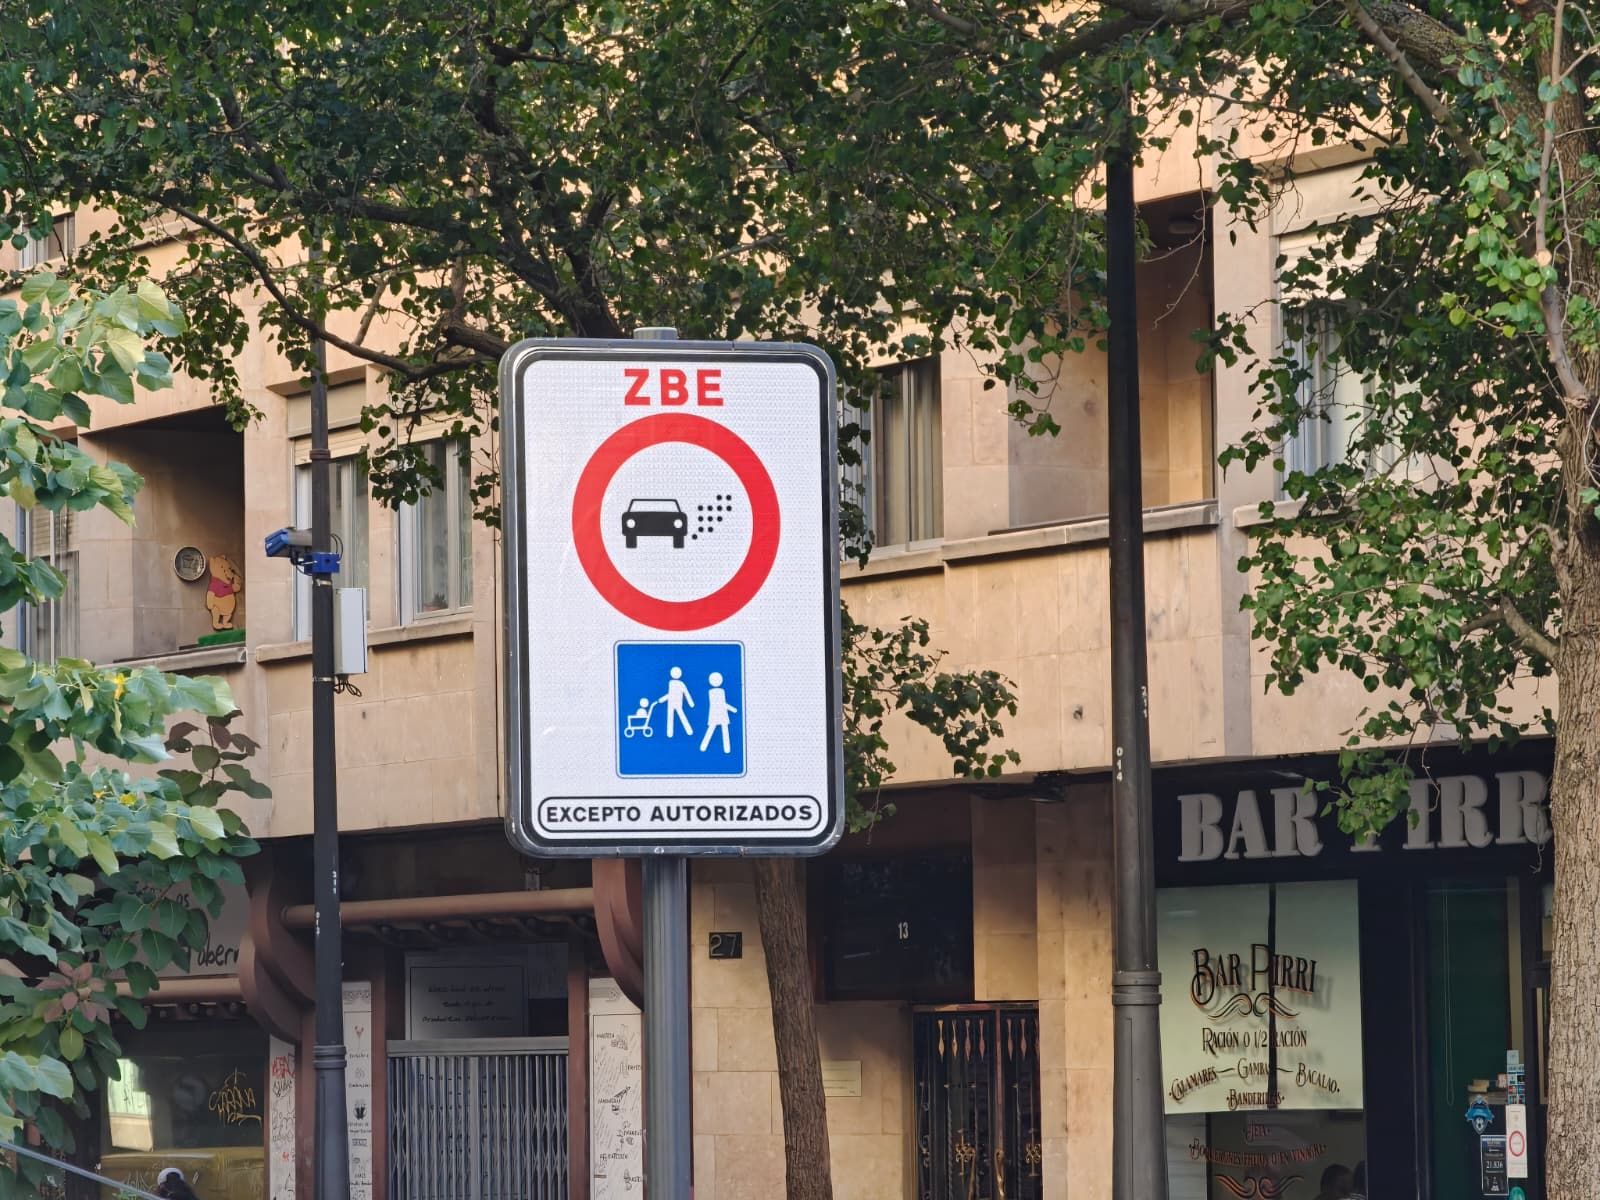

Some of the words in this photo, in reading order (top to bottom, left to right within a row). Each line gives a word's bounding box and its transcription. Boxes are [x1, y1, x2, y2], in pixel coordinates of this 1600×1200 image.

[624, 369, 724, 406] ZBE
[1116, 746, 1124, 781] 014
[547, 806, 641, 822] EXCEPTO
[650, 805, 812, 821] AUTORIZADOS
[1178, 786, 1323, 861] BAR
[1350, 771, 1552, 852] IRR
[898, 921, 909, 940] 13
[710, 934, 737, 957] 27
[1191, 948, 1242, 1005] BAR
[1251, 943, 1317, 993] PIRRI
[1237, 1058, 1272, 1079] GAMBA
[1228, 1088, 1281, 1111] BANDERIAS
